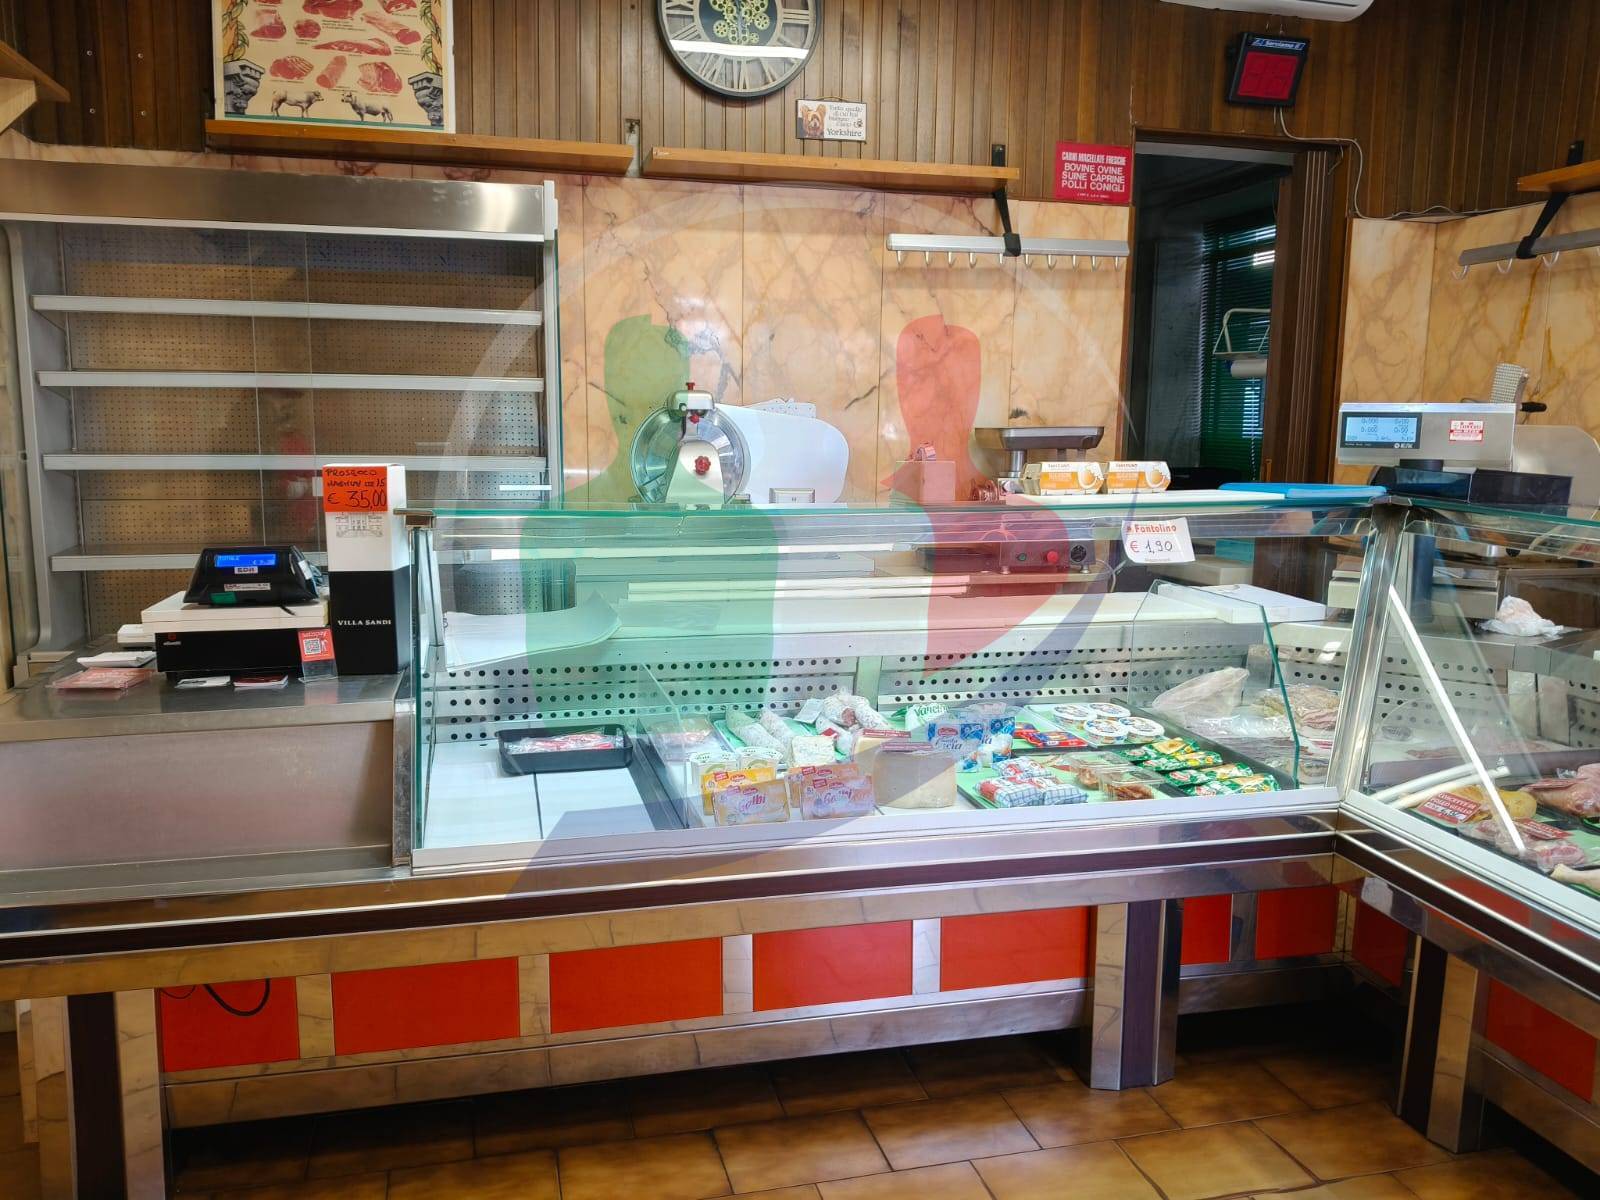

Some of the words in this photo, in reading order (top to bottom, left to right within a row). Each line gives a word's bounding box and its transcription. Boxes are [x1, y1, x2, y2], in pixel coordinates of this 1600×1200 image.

[827, 128, 862, 136] Yorkshire
[1064, 162, 1095, 172] BOVINE
[1098, 166, 1123, 175] OVINE
[1062, 172, 1087, 180] SUINE
[1090, 174, 1125, 184] CAPRINE
[1062, 180, 1087, 189] POLLI
[1090, 182, 1125, 192] CONIGLI
[328, 492, 340, 504] €
[345, 489, 386, 510] 35,00
[1134, 524, 1177, 533] Fantolino
[1130, 540, 1140, 553] €
[1145, 540, 1173, 554] 1,90
